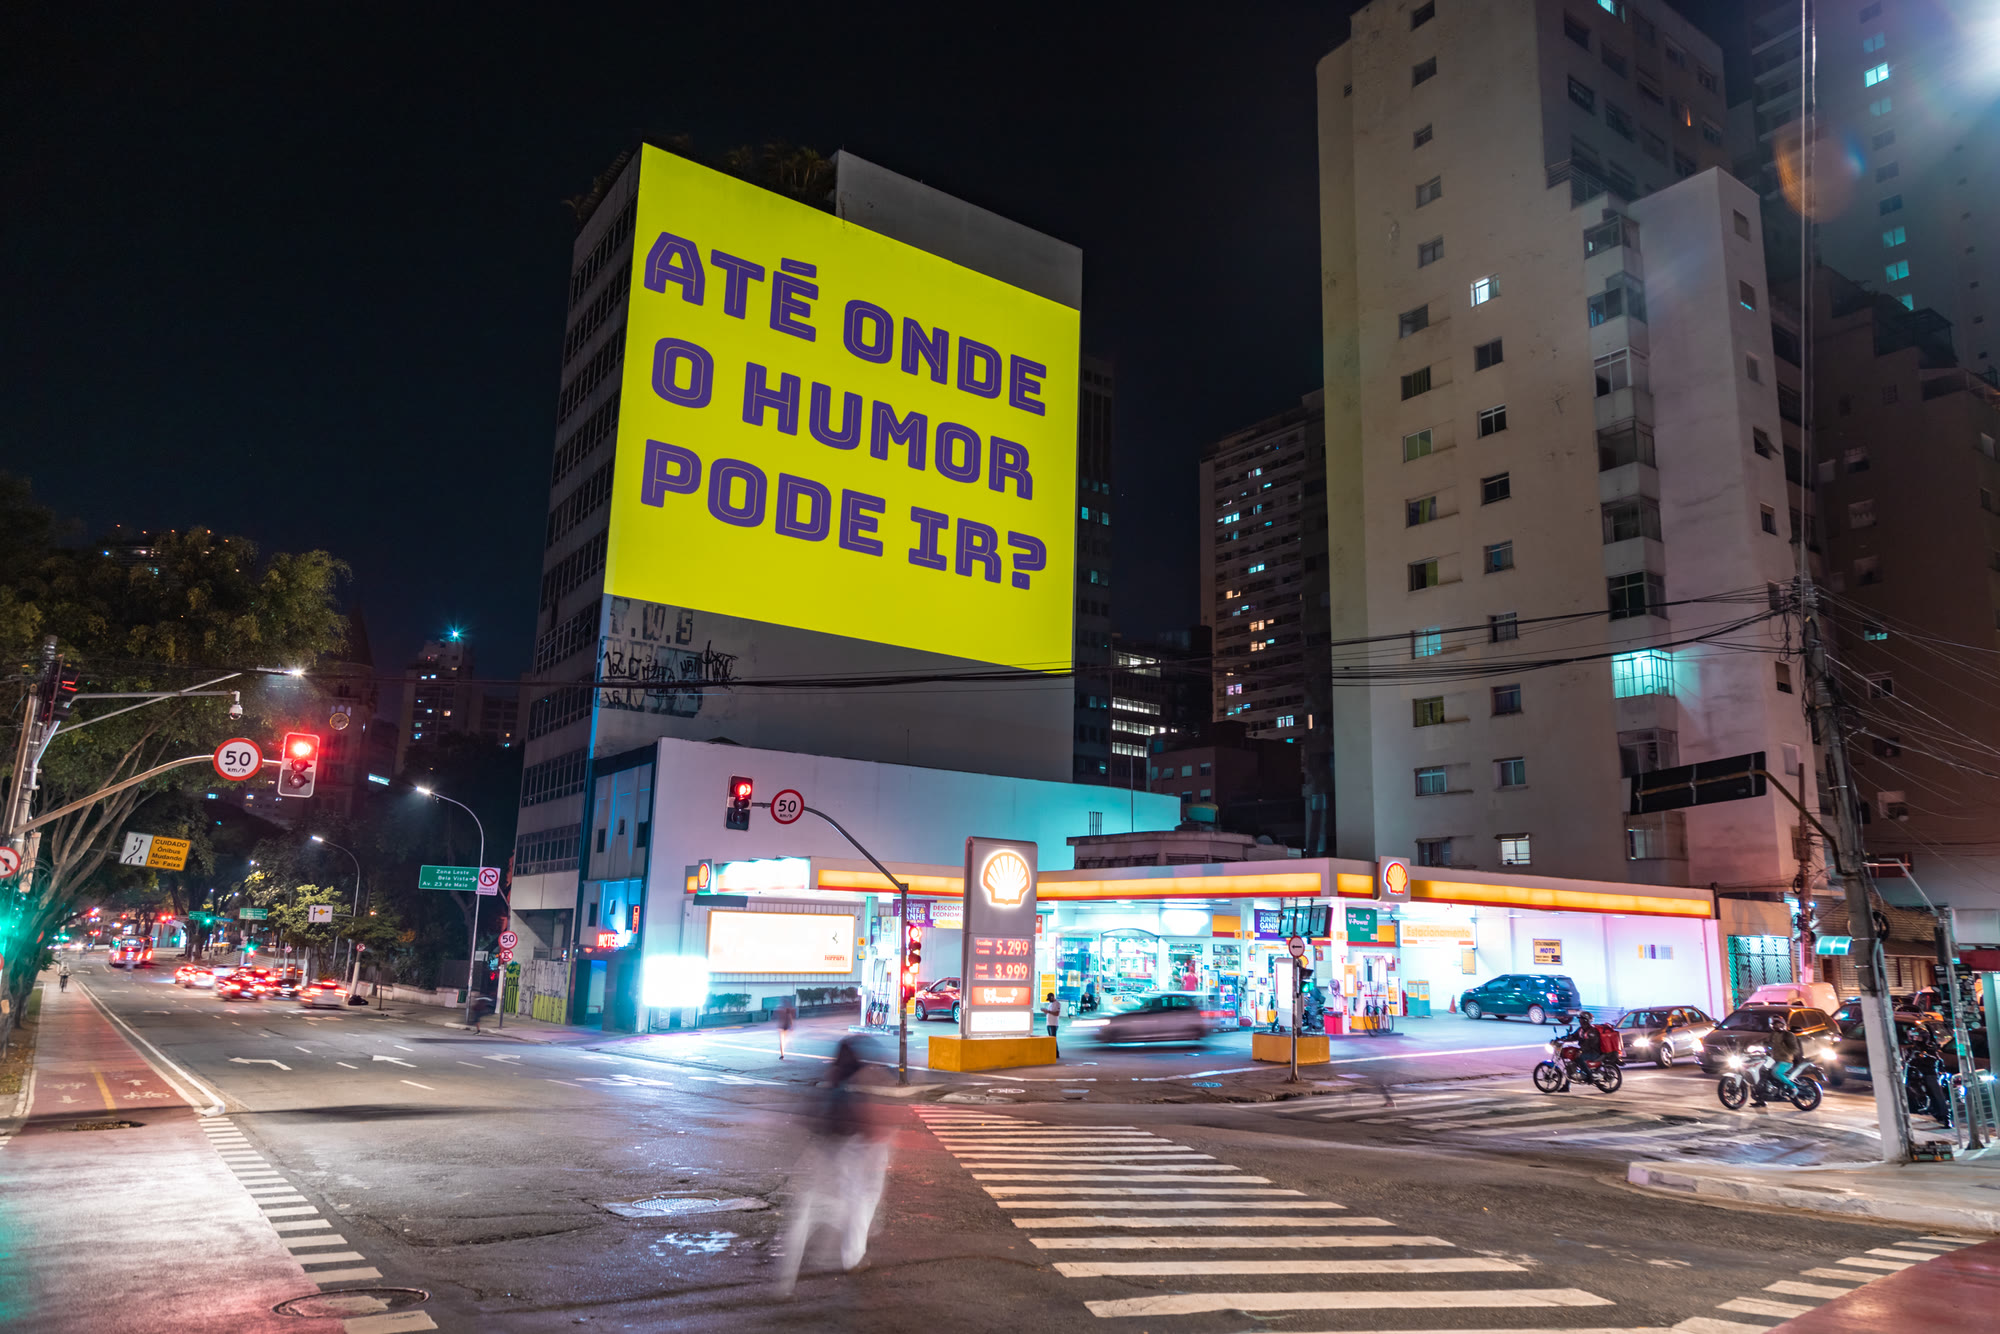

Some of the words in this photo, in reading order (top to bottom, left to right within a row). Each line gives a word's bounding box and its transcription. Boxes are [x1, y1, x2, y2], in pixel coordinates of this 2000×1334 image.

[644, 231, 819, 343] ATÉ
[843, 299, 1047, 416] ONDE
[651, 337, 715, 409] O
[742, 361, 1034, 501] HUMOR
[640, 438, 886, 557] PODE
[908, 505, 1048, 591] IR?
[224, 750, 252, 767] 50
[778, 799, 797, 813] 50
[155, 839, 187, 848] CUIDADO
[157, 846, 181, 855] Ônibus
[151, 852, 183, 862] Mudando
[162, 860, 181, 868] Faixa
[502, 934, 515, 944] 50
[1406, 926, 1471, 938] Estacionamento
[996, 939, 1029, 956] 5.299
[995, 963, 1028, 980] 3.999
